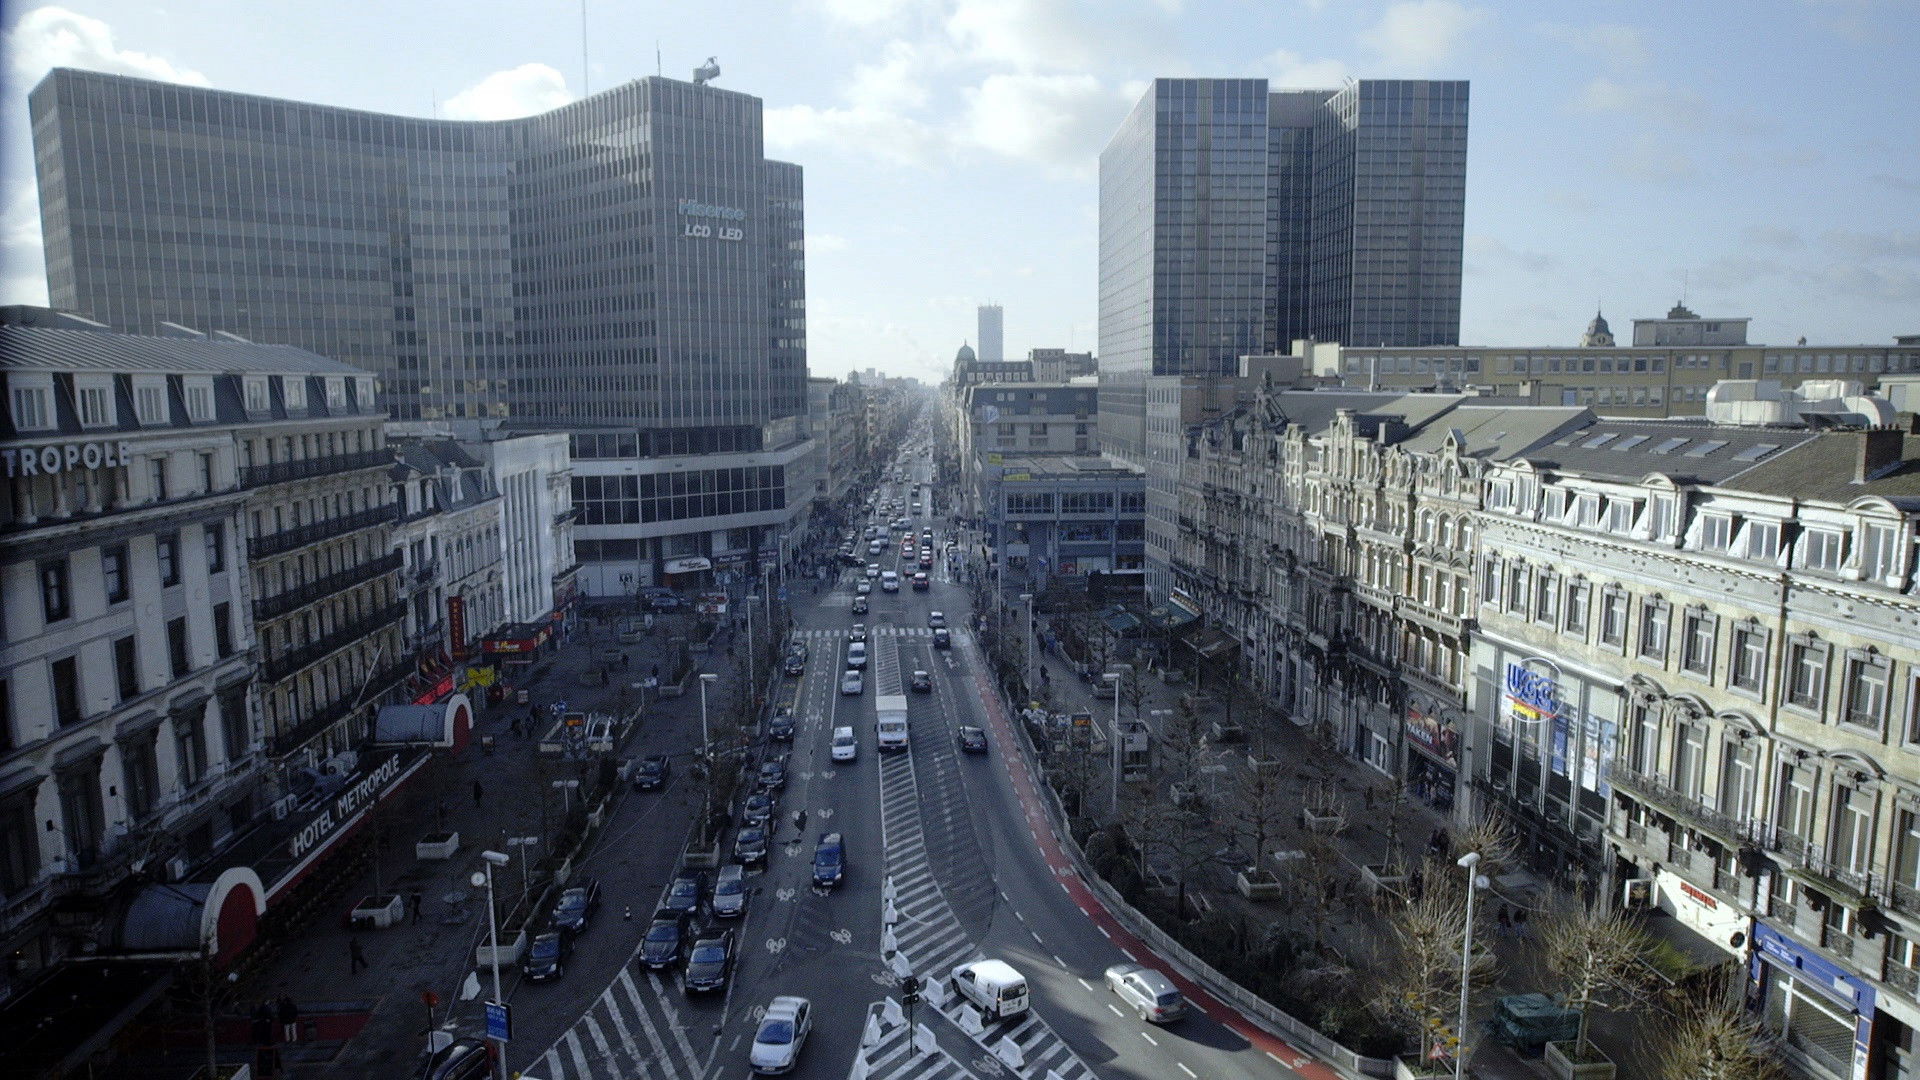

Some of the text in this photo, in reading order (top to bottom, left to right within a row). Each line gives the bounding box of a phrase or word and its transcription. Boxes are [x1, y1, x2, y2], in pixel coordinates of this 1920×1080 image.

[678, 197, 745, 221] Hisense
[685, 223, 744, 241] LCD LED
[1, 441, 131, 478] TROPOLE
[1507, 663, 1554, 712] UGC
[293, 753, 400, 858] HOTEL METROPOLE
